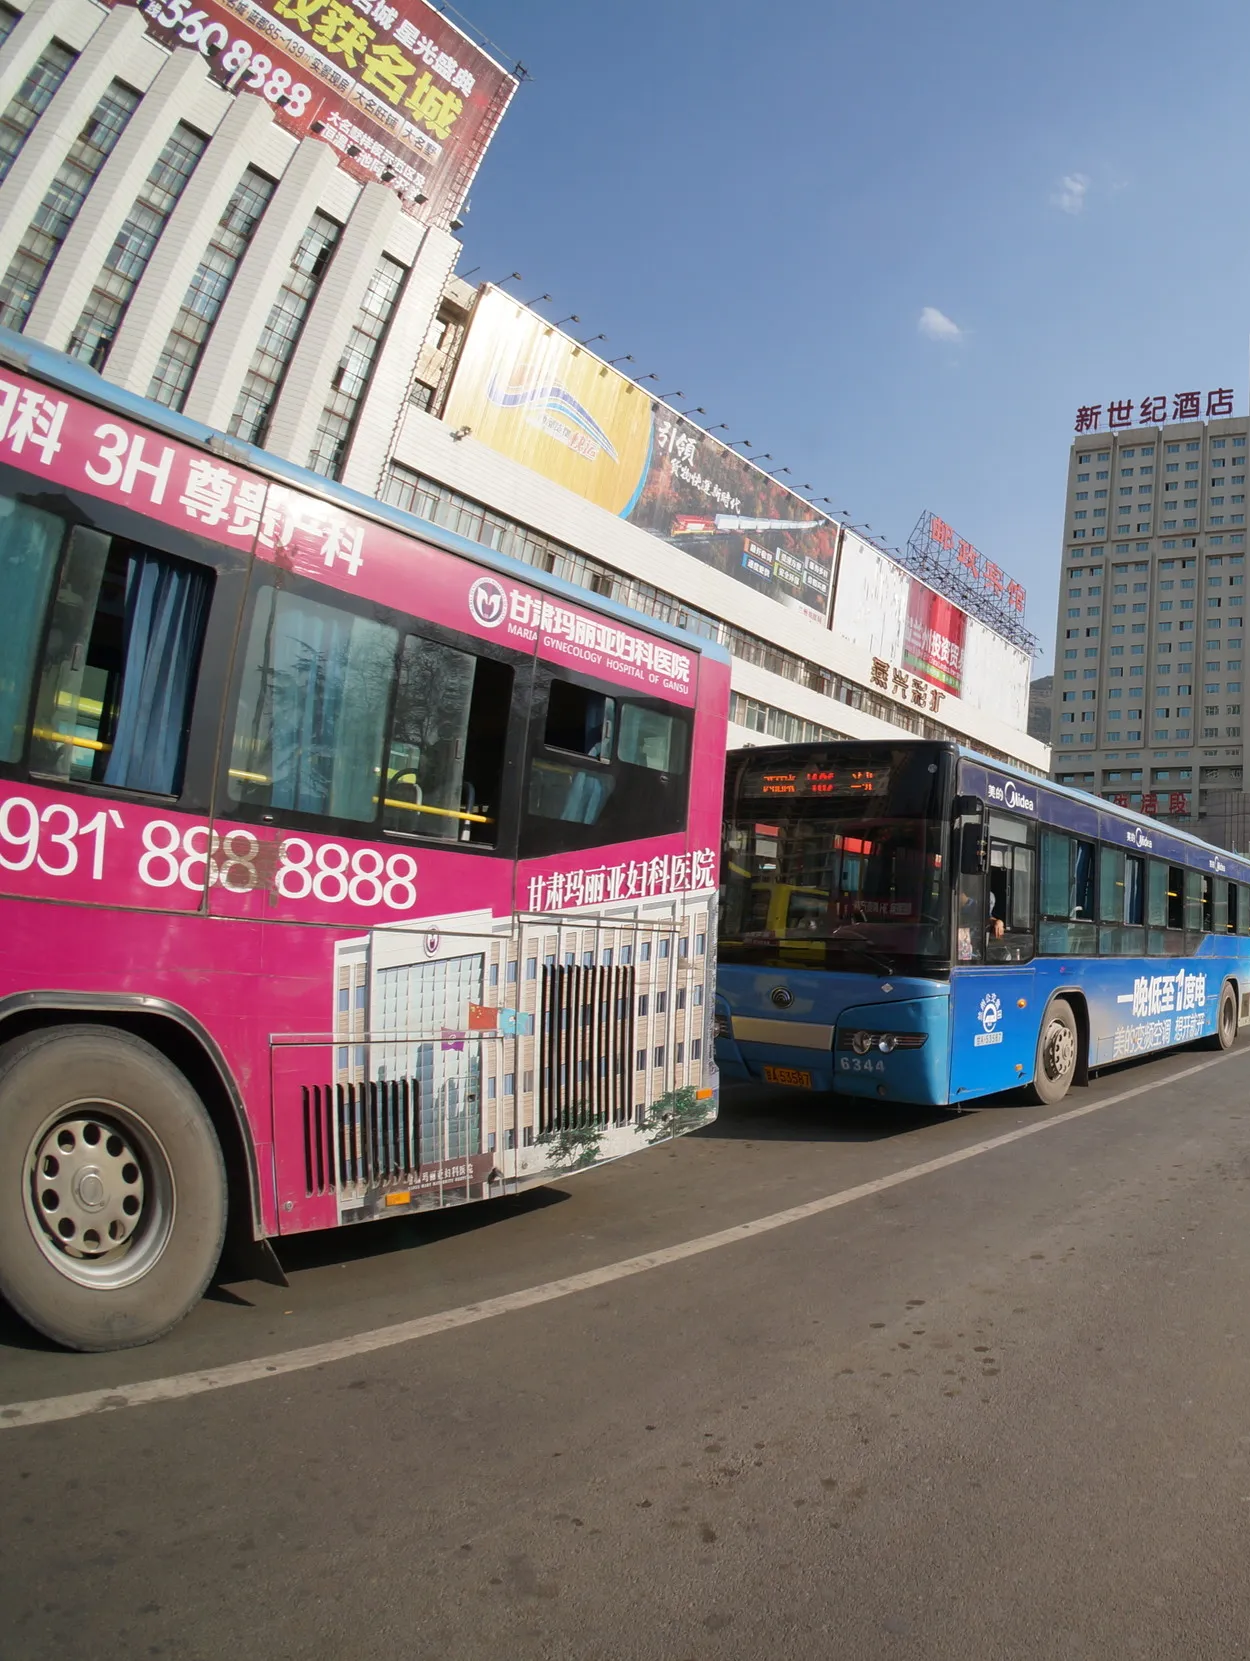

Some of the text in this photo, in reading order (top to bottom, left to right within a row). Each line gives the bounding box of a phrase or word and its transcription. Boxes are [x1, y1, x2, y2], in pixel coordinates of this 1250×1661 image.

[393, 19, 476, 97] 星光盛典
[1074, 388, 1235, 433] 新世纪酒店
[85, 423, 176, 505] 3H
[930, 517, 1025, 613] 邮政宾馆
[507, 622, 689, 695] MARIA GYNECOLOGY HOSPITAL OF GANSU
[509, 589, 690, 683] 甘肃玛丽亚妇科医院
[988, 781, 1034, 811] 美的 Midea
[527, 847, 716, 912] 甘肃玛丽亚妇科医院
[1117, 968, 1206, 1018] 一晚低至1度电
[840, 1057, 886, 1072] 6344
